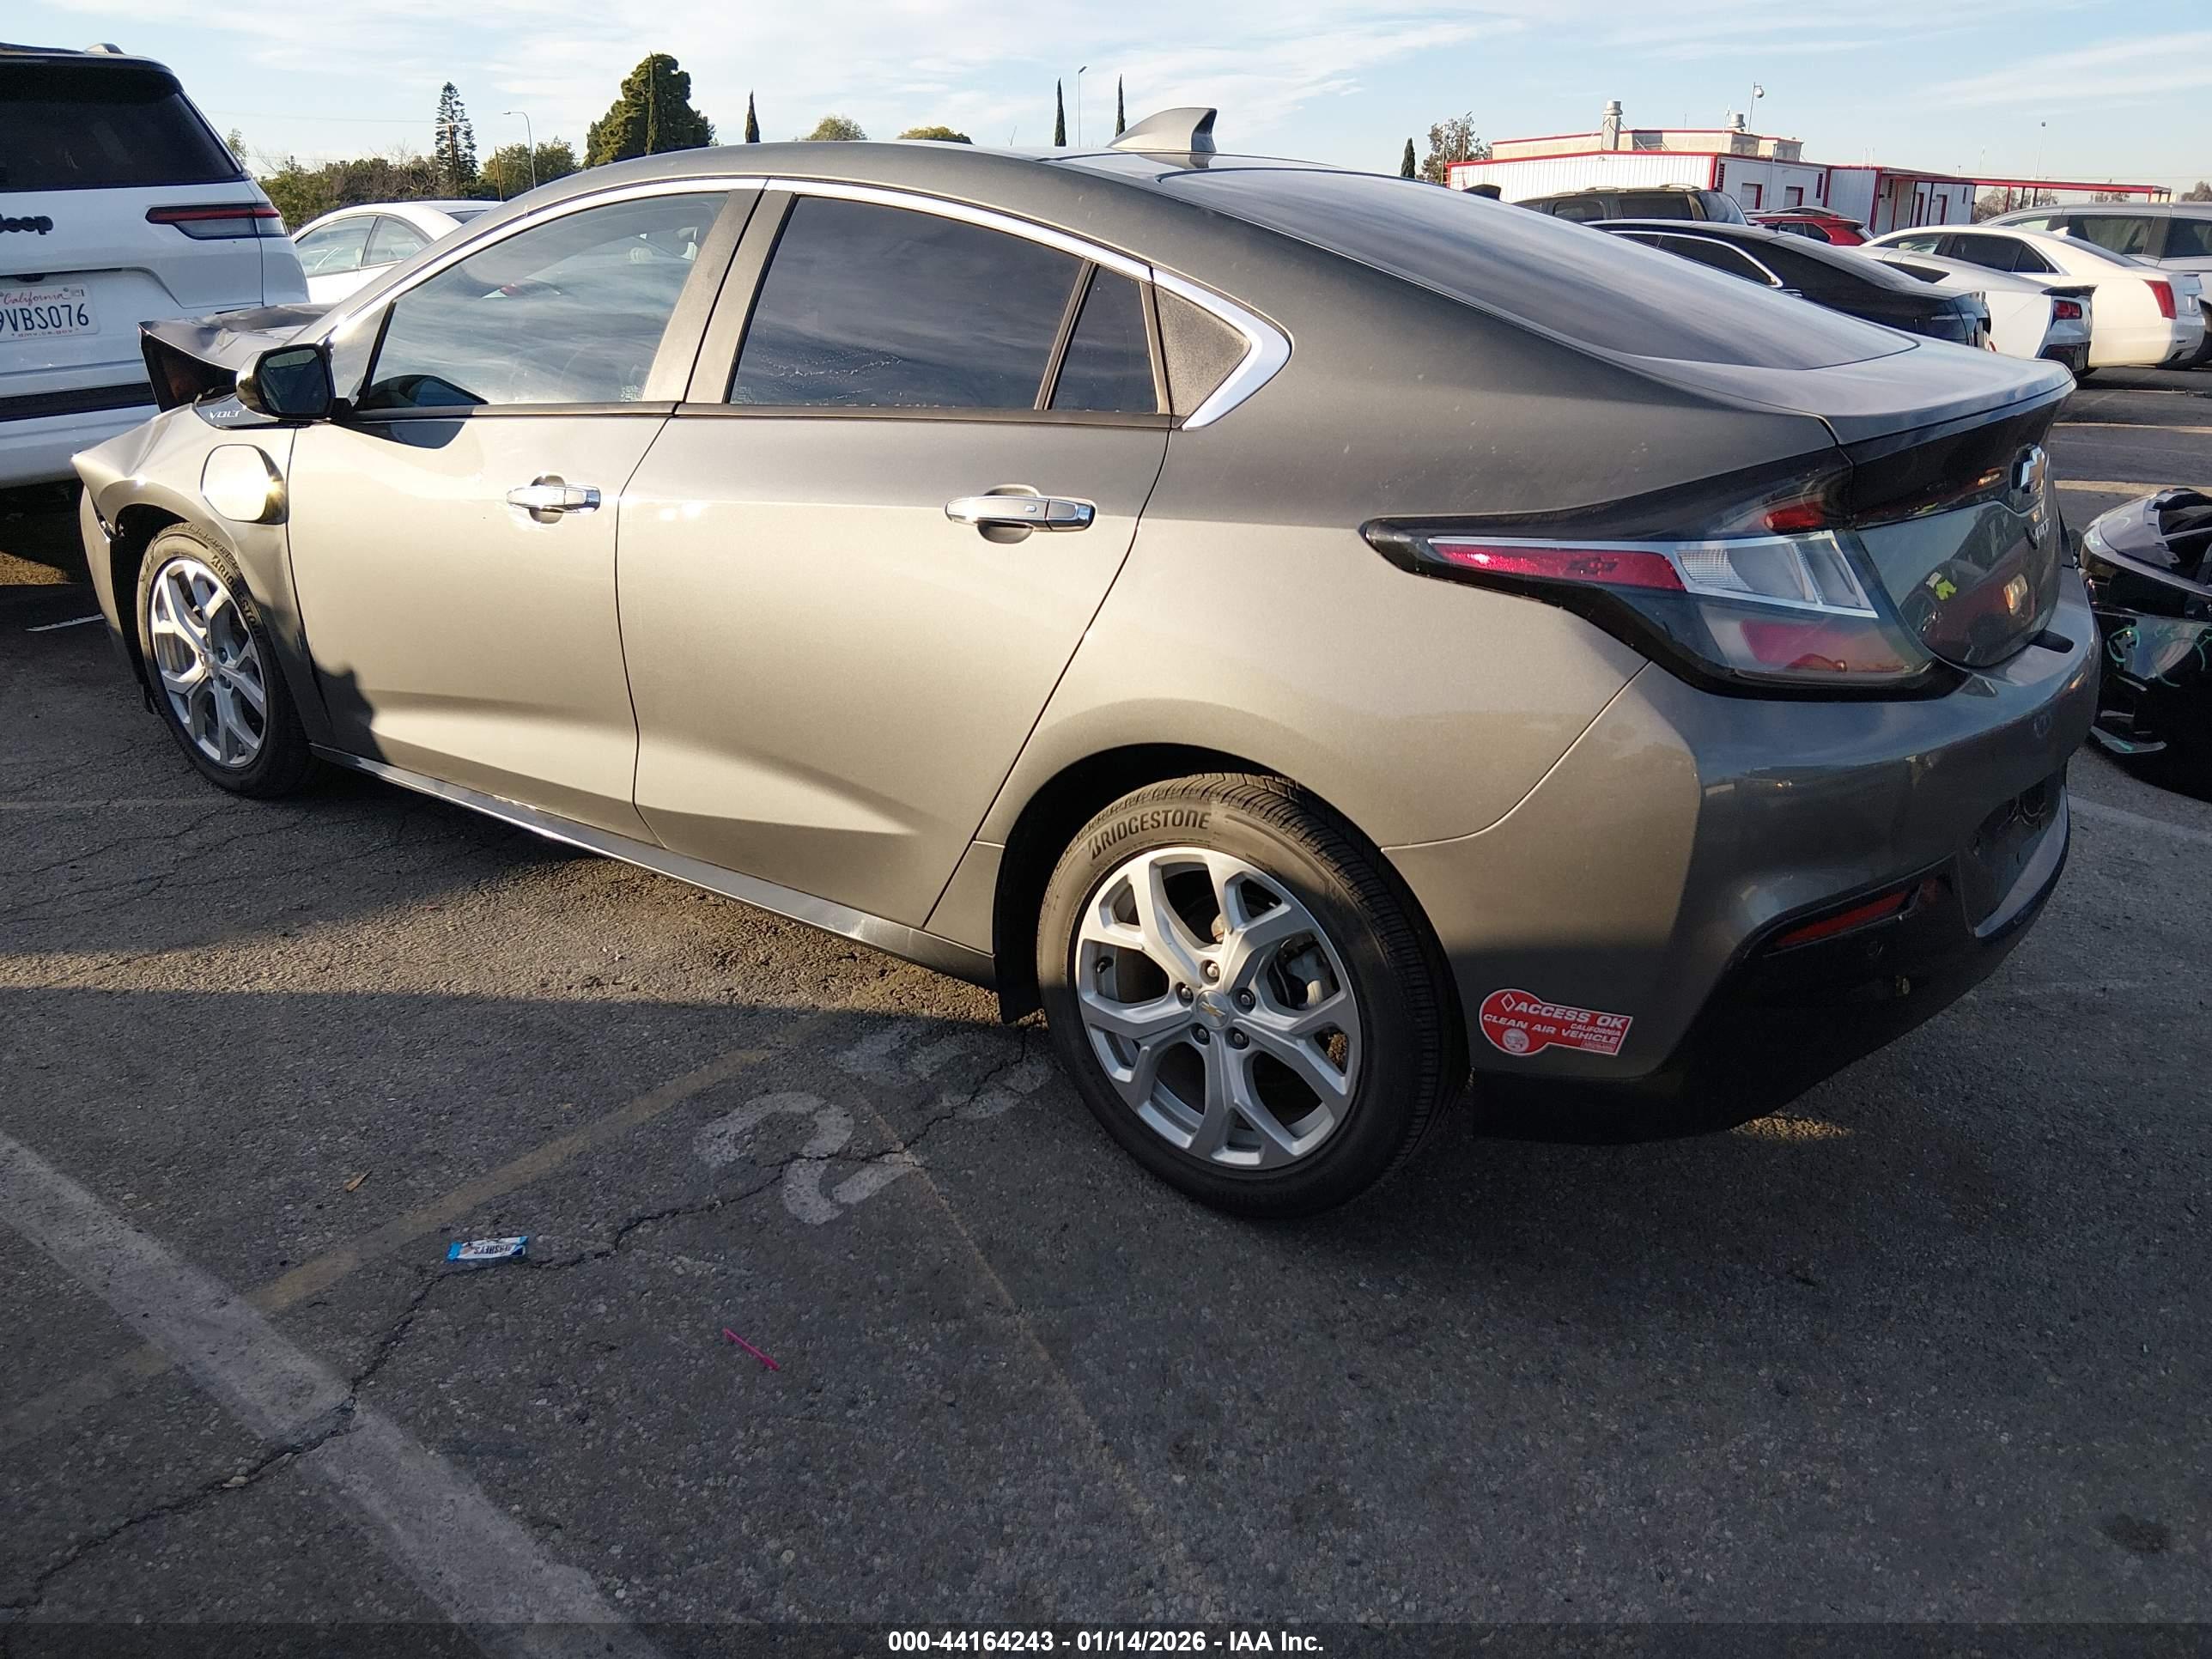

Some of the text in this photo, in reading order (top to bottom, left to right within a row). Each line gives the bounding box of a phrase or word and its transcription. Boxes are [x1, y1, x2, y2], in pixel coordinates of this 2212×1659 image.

[0, 214, 53, 235] eep
[210, 409, 242, 420] VOLT
[1087, 809, 1212, 860] BRIDGESTONE
[1515, 1001, 1627, 1029] ACCESS OK
[1483, 1013, 1619, 1045] CLEAN AIR VEHICLE
[1571, 1023, 1621, 1036] CALIFORNIA
